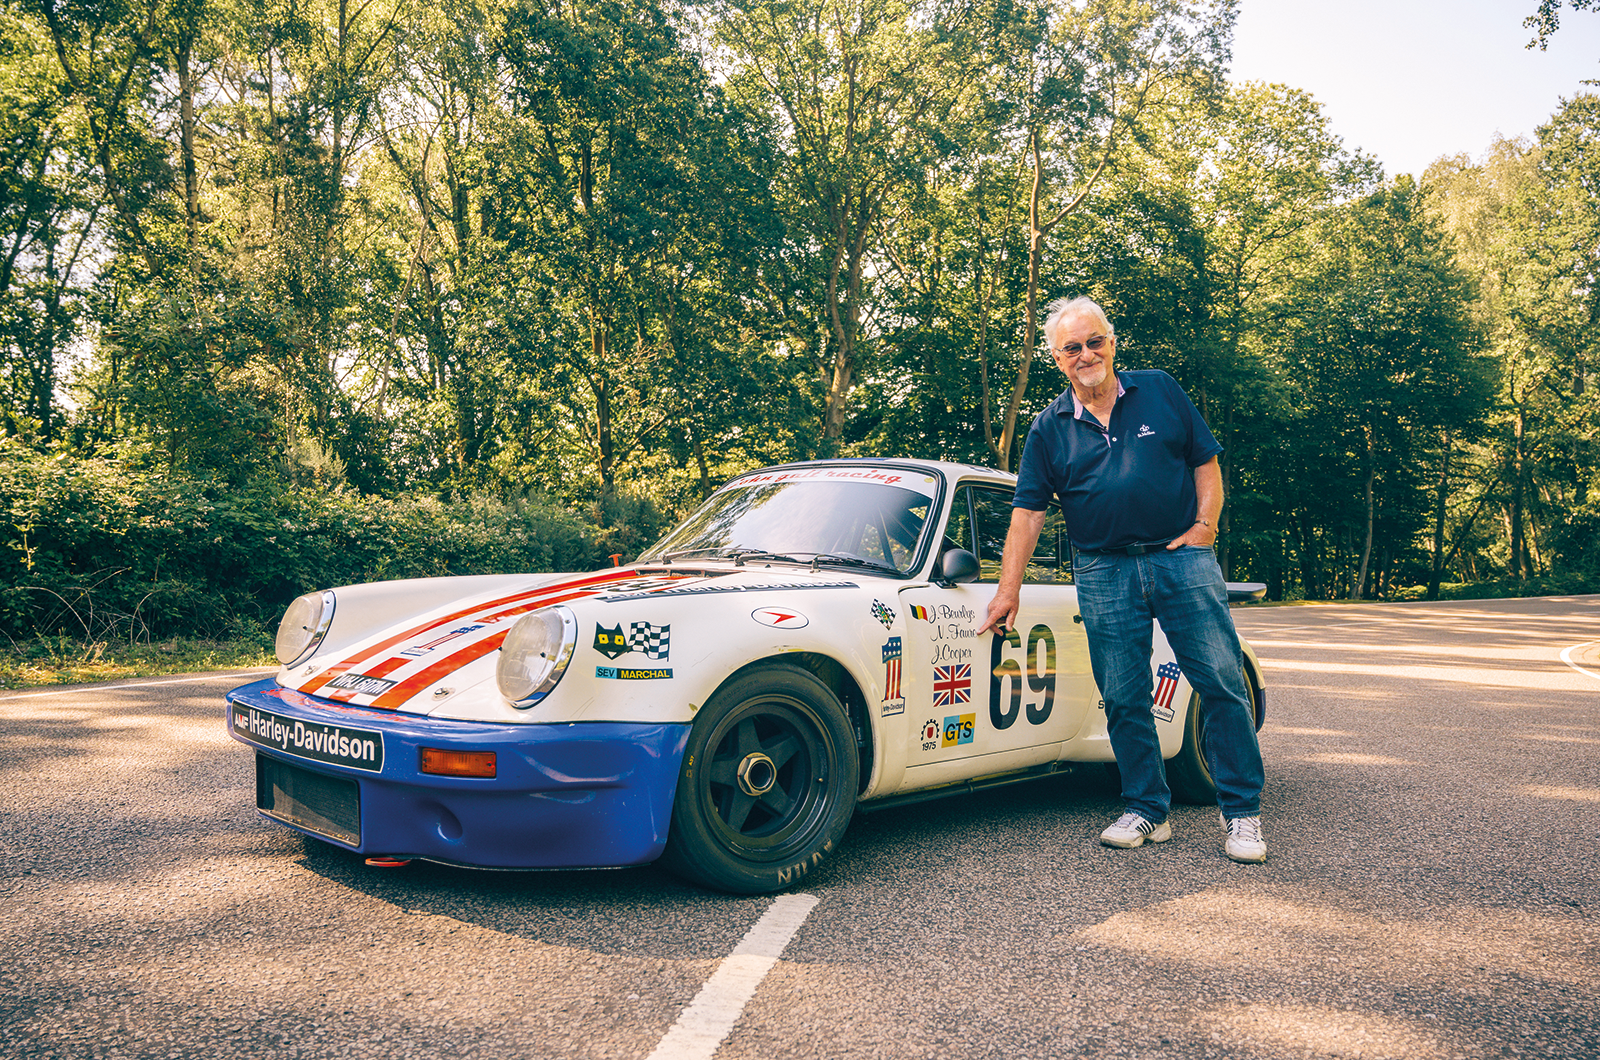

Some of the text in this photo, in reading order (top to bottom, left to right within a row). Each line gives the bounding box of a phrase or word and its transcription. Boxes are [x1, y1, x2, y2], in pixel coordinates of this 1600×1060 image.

[824, 469, 903, 484] racing
[938, 604, 975, 623] Beurlys
[948, 623, 977, 640] Faure
[597, 667, 670, 679] SEV MARCHAL
[989, 623, 1057, 730] 69
[235, 712, 249, 730] AMF
[945, 720, 973, 741] GTS
[922, 741, 937, 751] 1975
